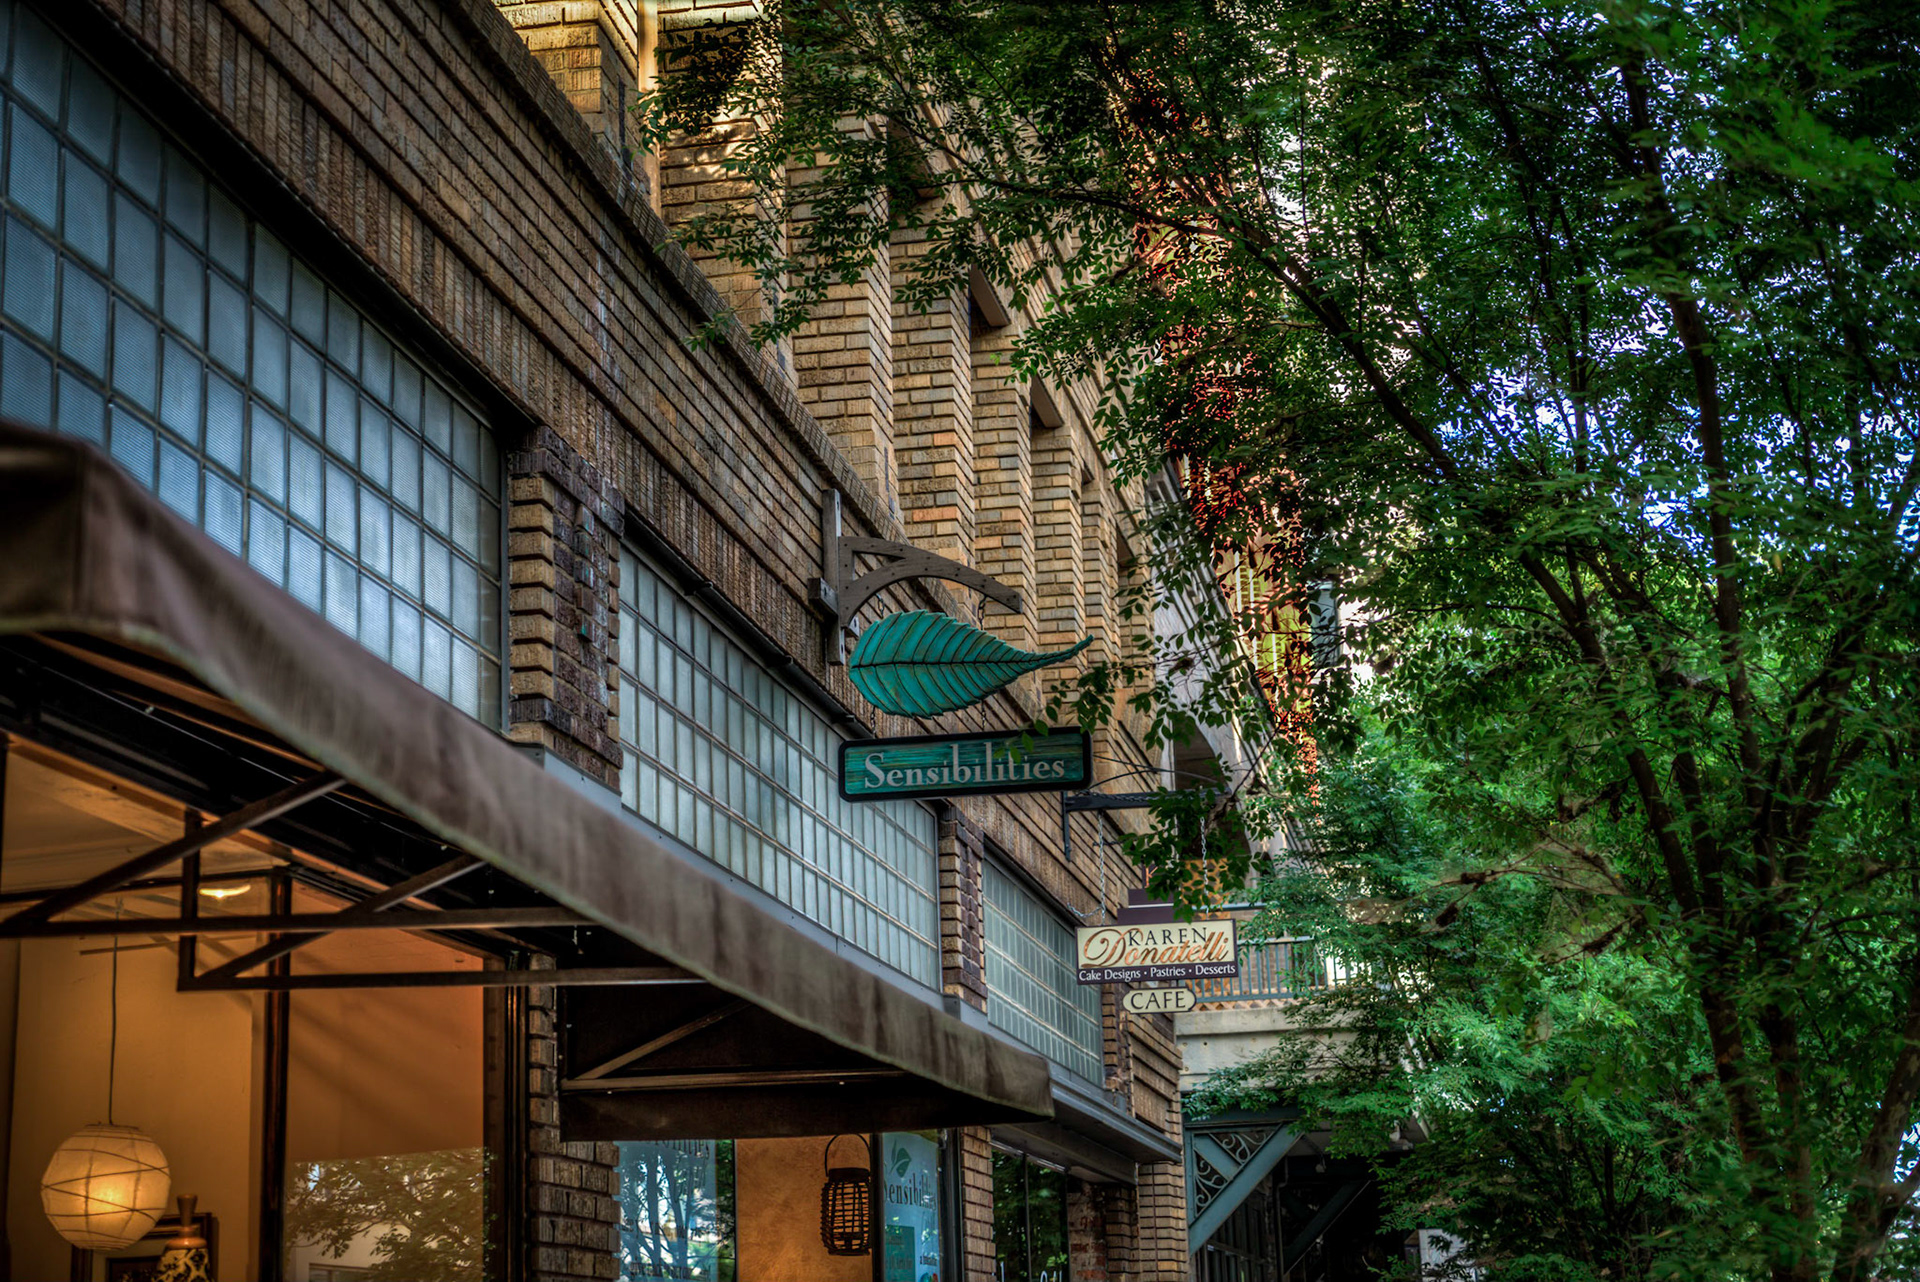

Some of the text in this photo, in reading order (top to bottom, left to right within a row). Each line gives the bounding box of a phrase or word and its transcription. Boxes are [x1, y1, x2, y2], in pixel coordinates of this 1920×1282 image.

[864, 742, 1065, 789] Sensibilities
[1128, 926, 1208, 947] KAREN
[1080, 927, 1230, 969] Donatelli
[1078, 964, 1236, 983] Cake Designs Pastries Desserts
[1130, 991, 1186, 1011] CAFE
